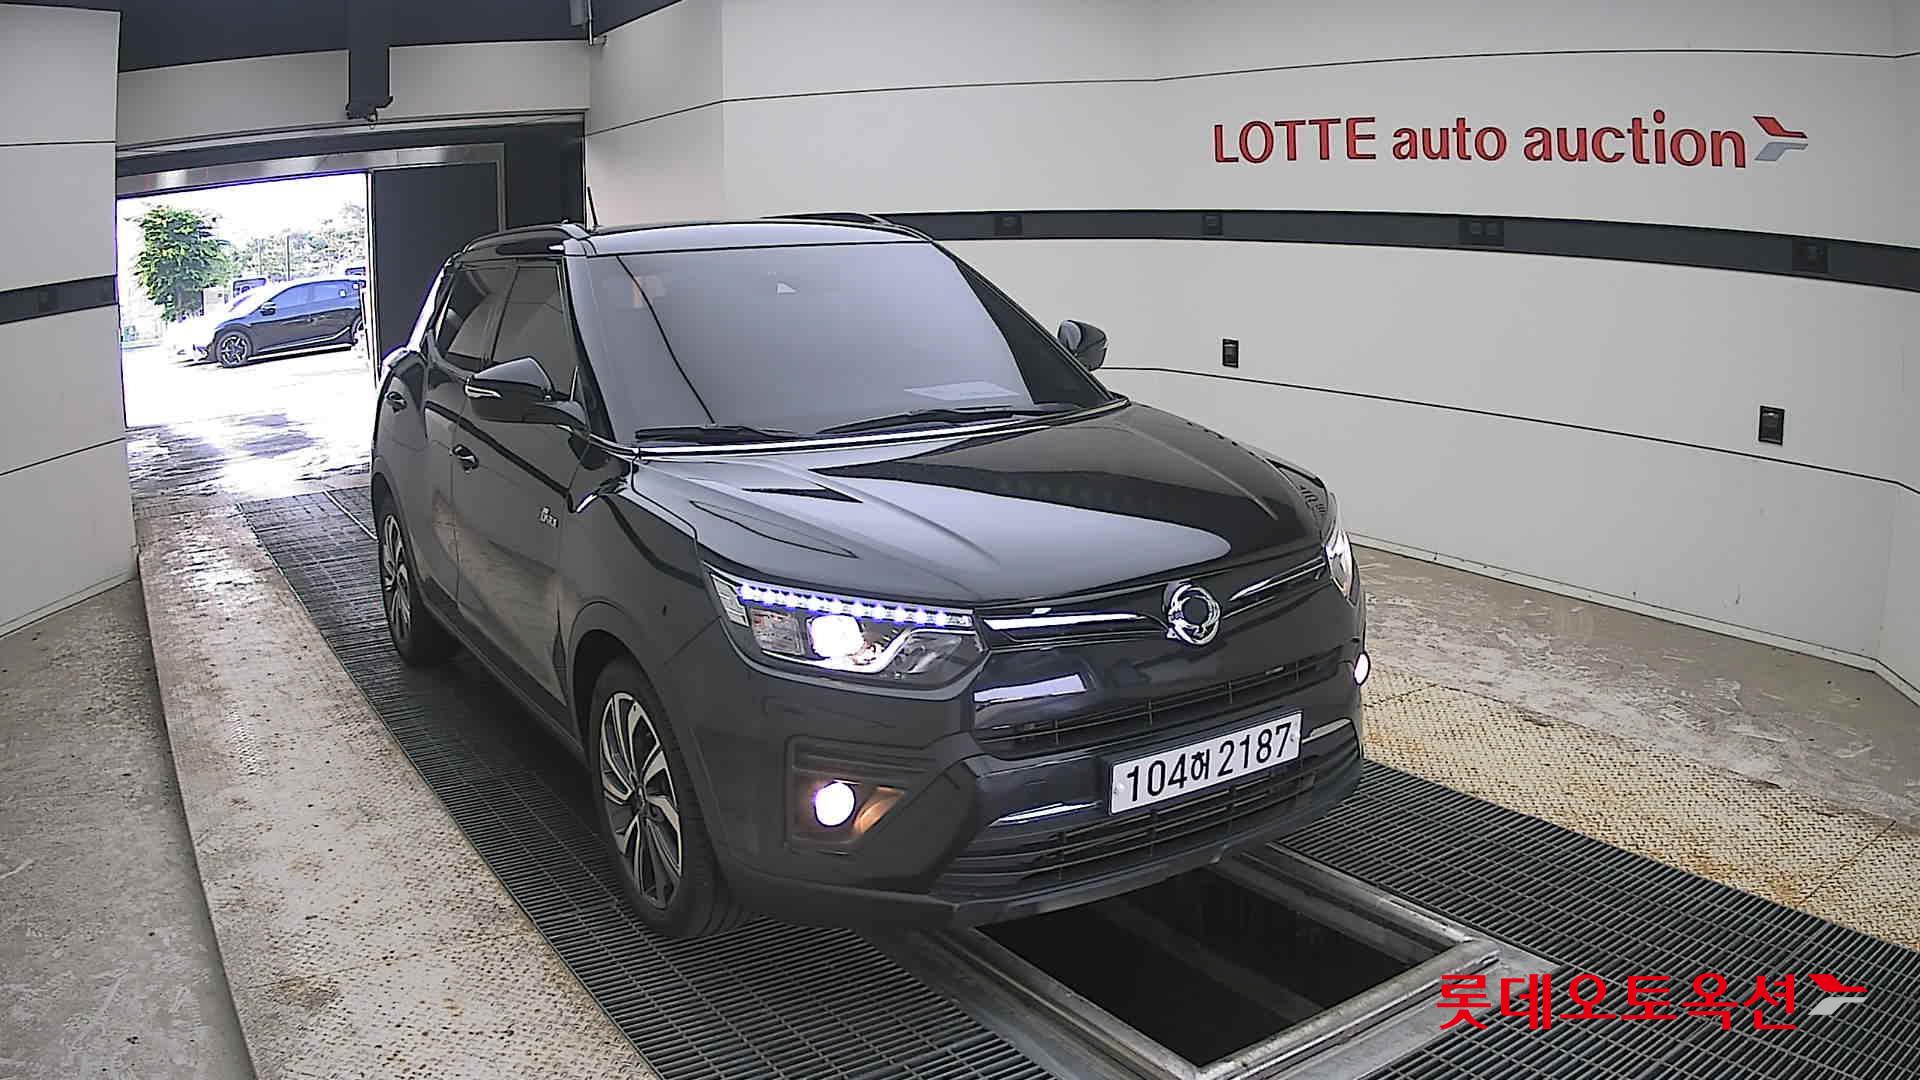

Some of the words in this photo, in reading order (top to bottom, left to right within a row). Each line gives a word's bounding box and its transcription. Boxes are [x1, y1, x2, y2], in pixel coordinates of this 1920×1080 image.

[1214, 117, 1377, 163] LOTTE
[1392, 117, 1508, 161] auto
[1523, 109, 1747, 168] auction
[1217, 722, 1292, 777] 2187
